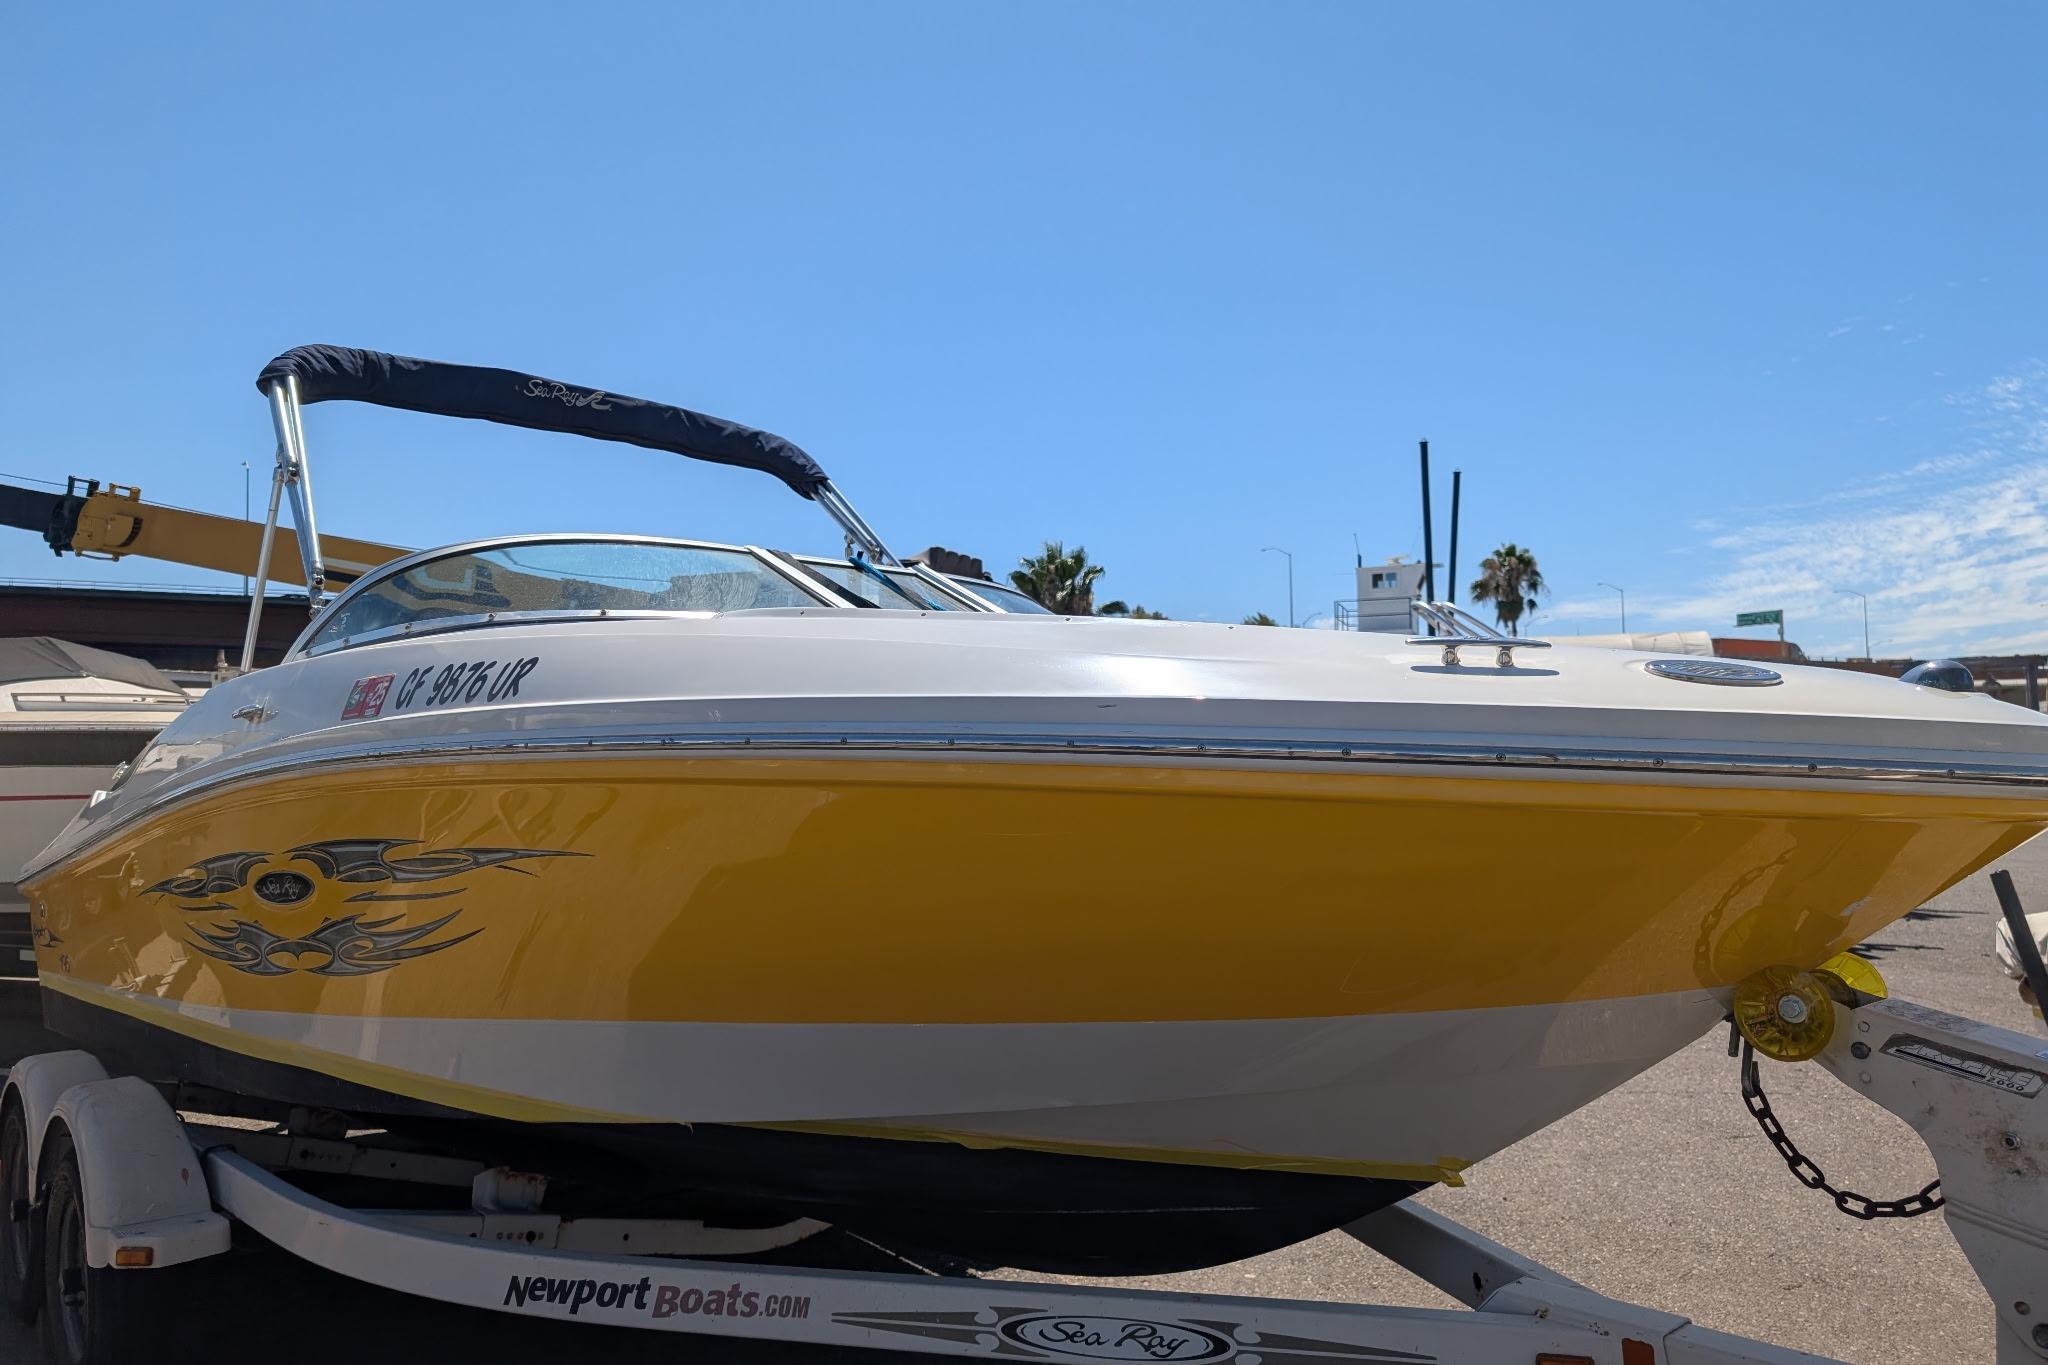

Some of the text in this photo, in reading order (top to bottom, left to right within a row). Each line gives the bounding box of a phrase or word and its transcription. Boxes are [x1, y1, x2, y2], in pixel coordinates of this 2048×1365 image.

[523, 379, 579, 407] Sea Ray
[395, 656, 540, 710] CF 9876 UR
[282, 875, 302, 899] Ray
[1986, 1076, 2025, 1092] 2000
[1038, 1321, 1190, 1359] Sea Ray
